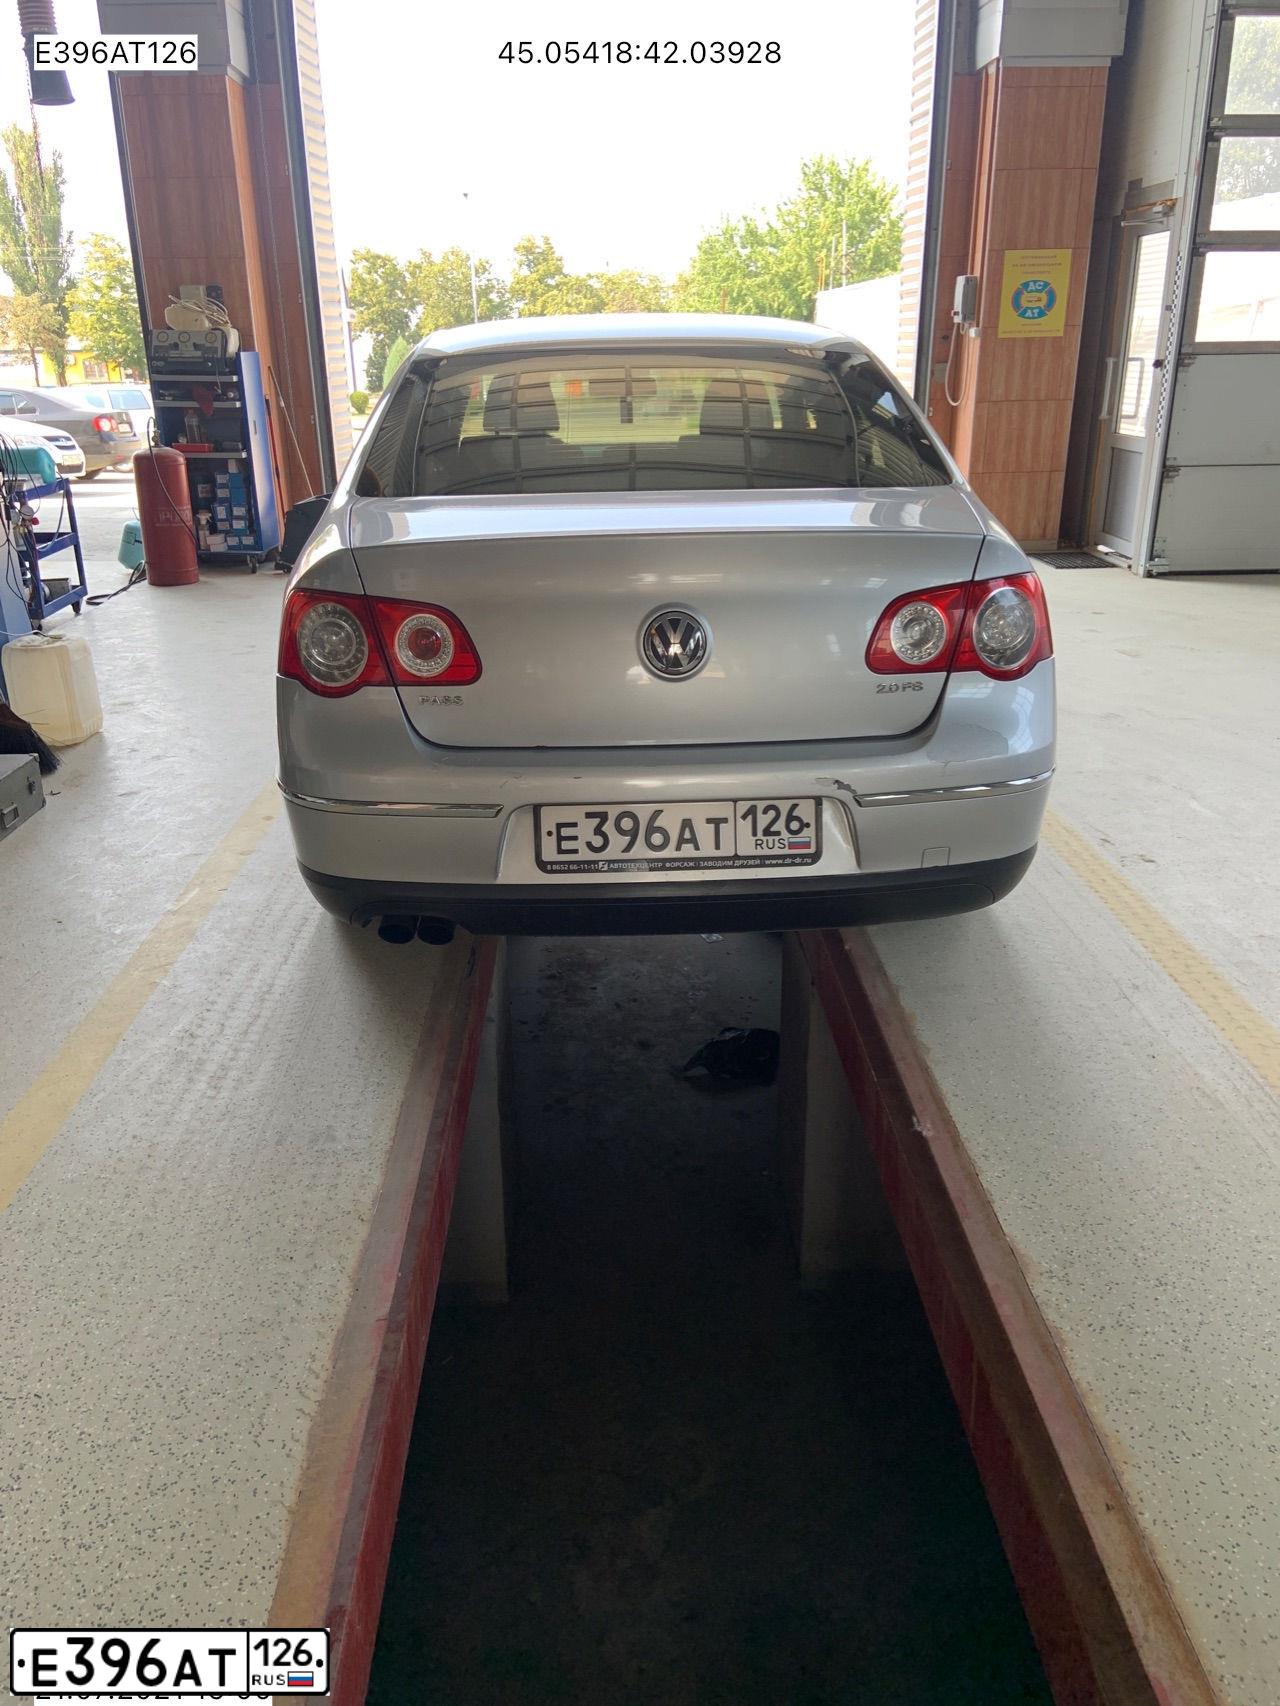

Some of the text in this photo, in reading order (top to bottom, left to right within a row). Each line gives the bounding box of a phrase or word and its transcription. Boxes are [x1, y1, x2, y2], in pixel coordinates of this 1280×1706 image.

[556, 803, 805, 855] E396AT 126
[754, 837, 786, 850] RUS
